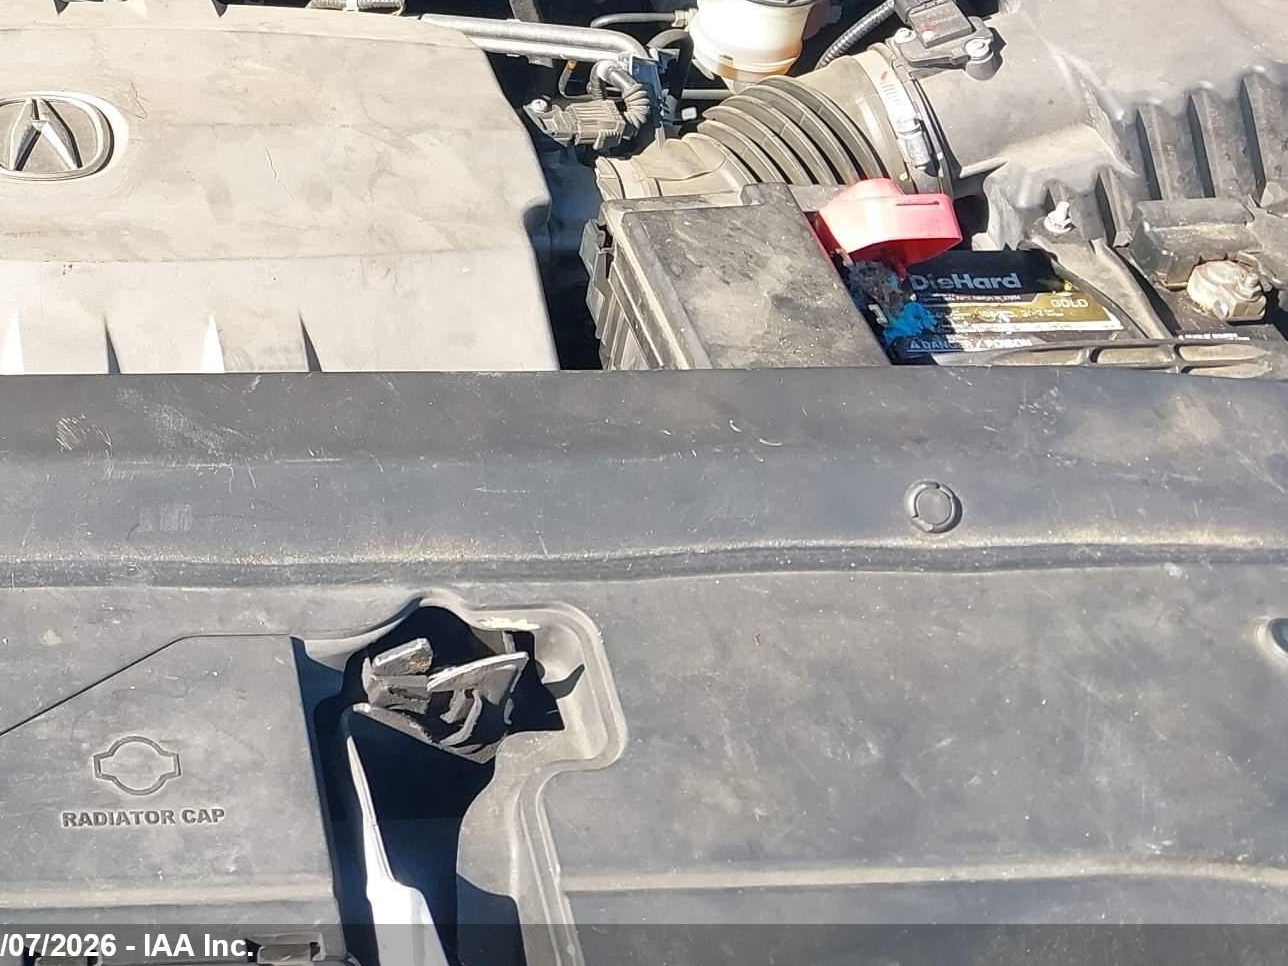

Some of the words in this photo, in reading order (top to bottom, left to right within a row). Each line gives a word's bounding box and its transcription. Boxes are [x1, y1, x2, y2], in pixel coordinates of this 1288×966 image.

[910, 272, 1023, 291] DieHard
[1050, 298, 1089, 308] GOLD
[61, 809, 176, 828] RADIATOR
[181, 808, 226, 825] CAP
